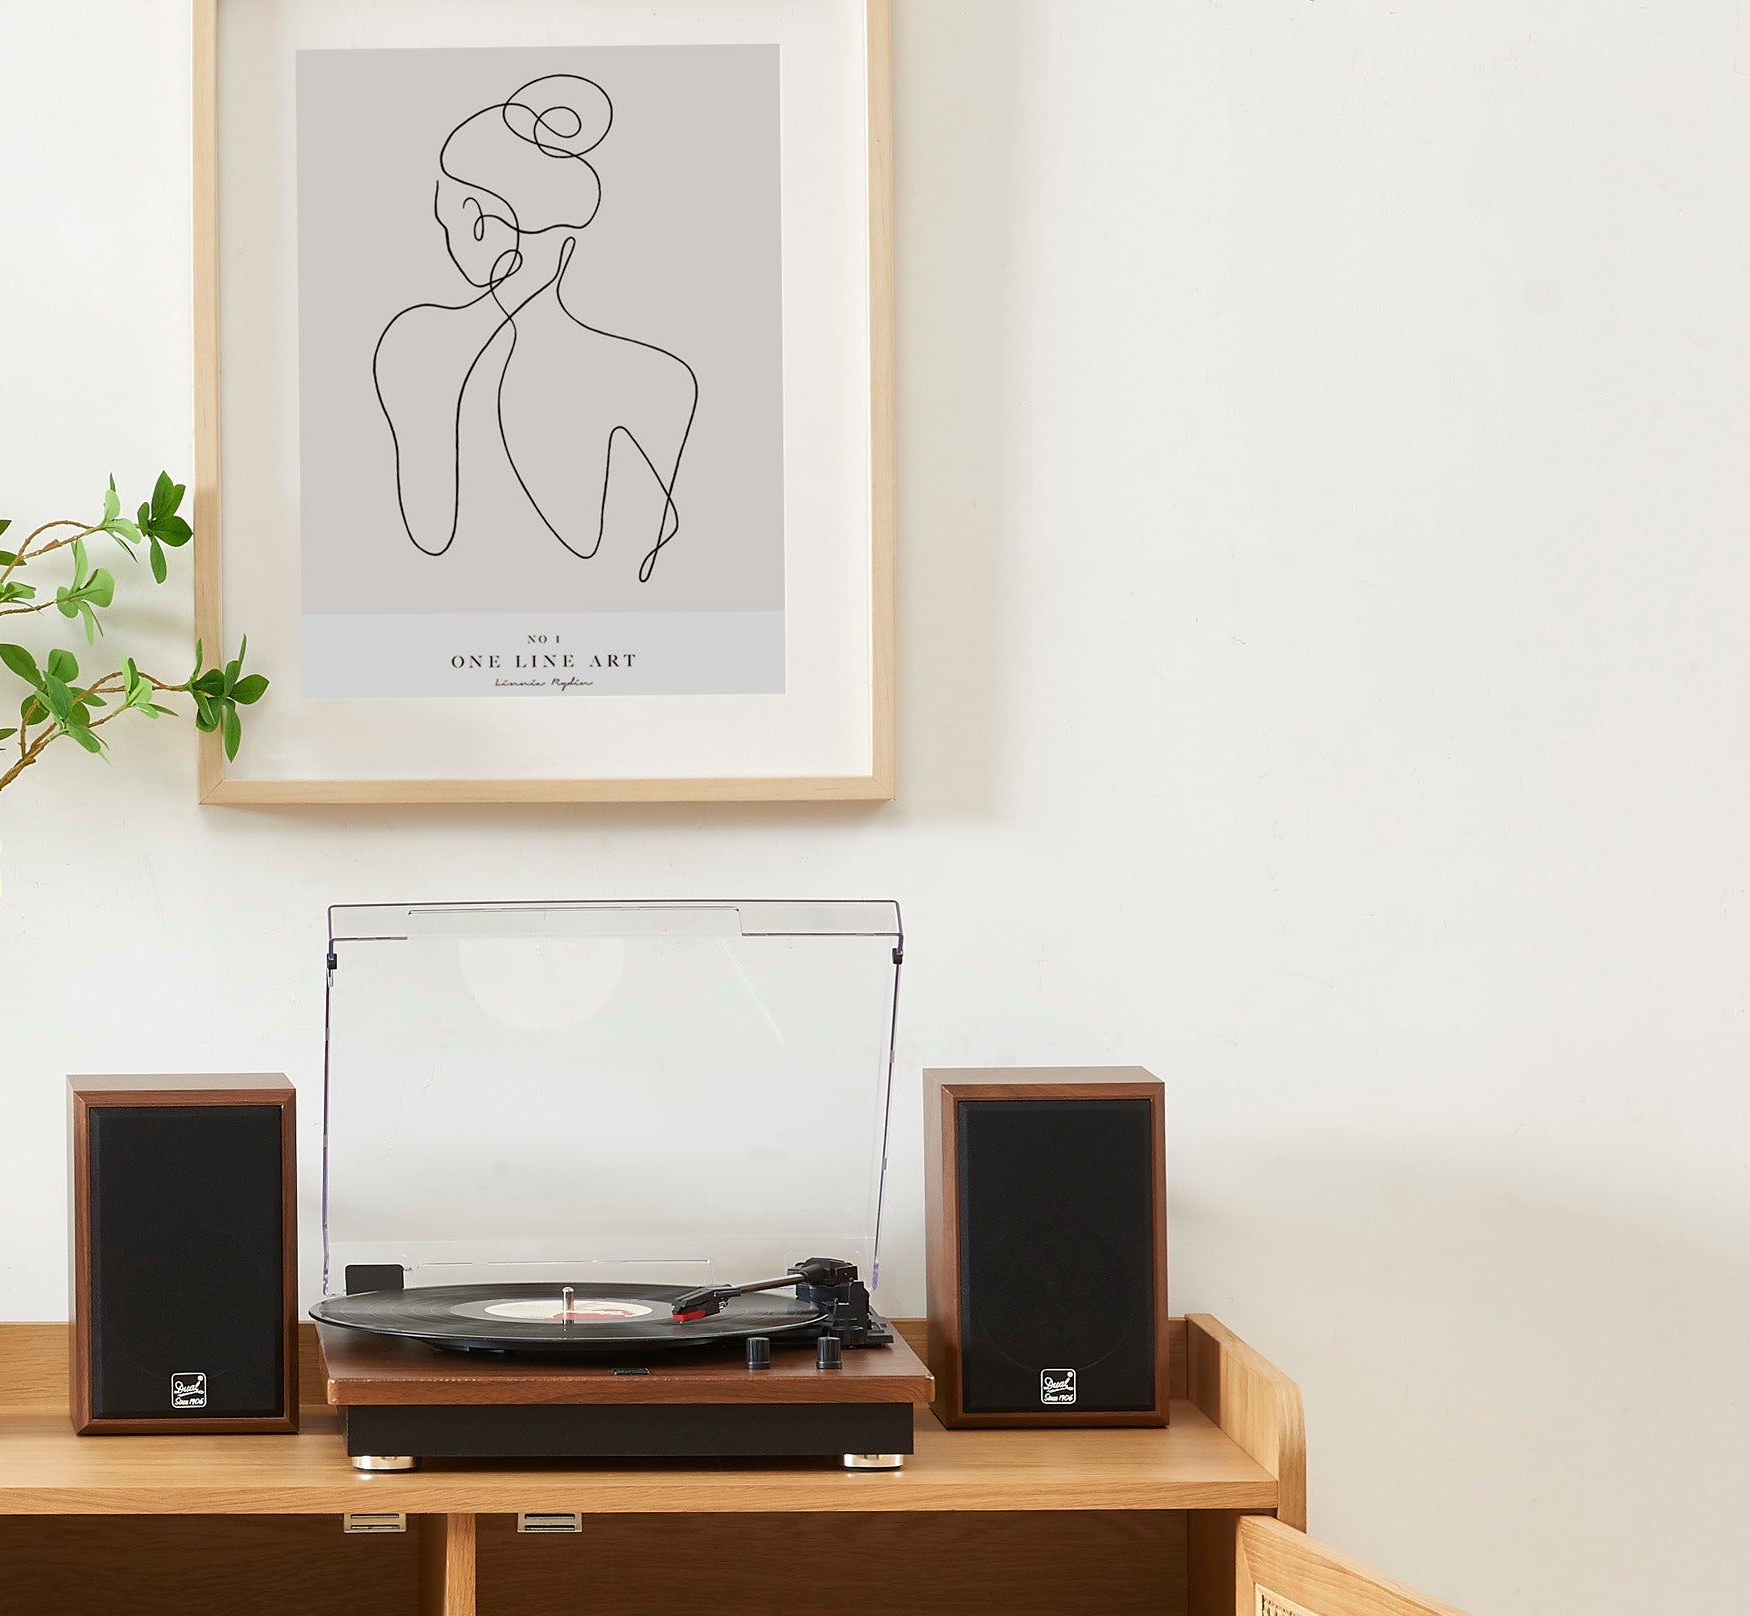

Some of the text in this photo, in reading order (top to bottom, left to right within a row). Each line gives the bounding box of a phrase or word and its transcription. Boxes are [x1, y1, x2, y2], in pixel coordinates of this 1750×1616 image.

[527, 635, 548, 644] NO
[451, 654, 636, 668] ONE LINE ART
[175, 1381, 201, 1393] Dual
[1044, 1377, 1070, 1390] Dual
